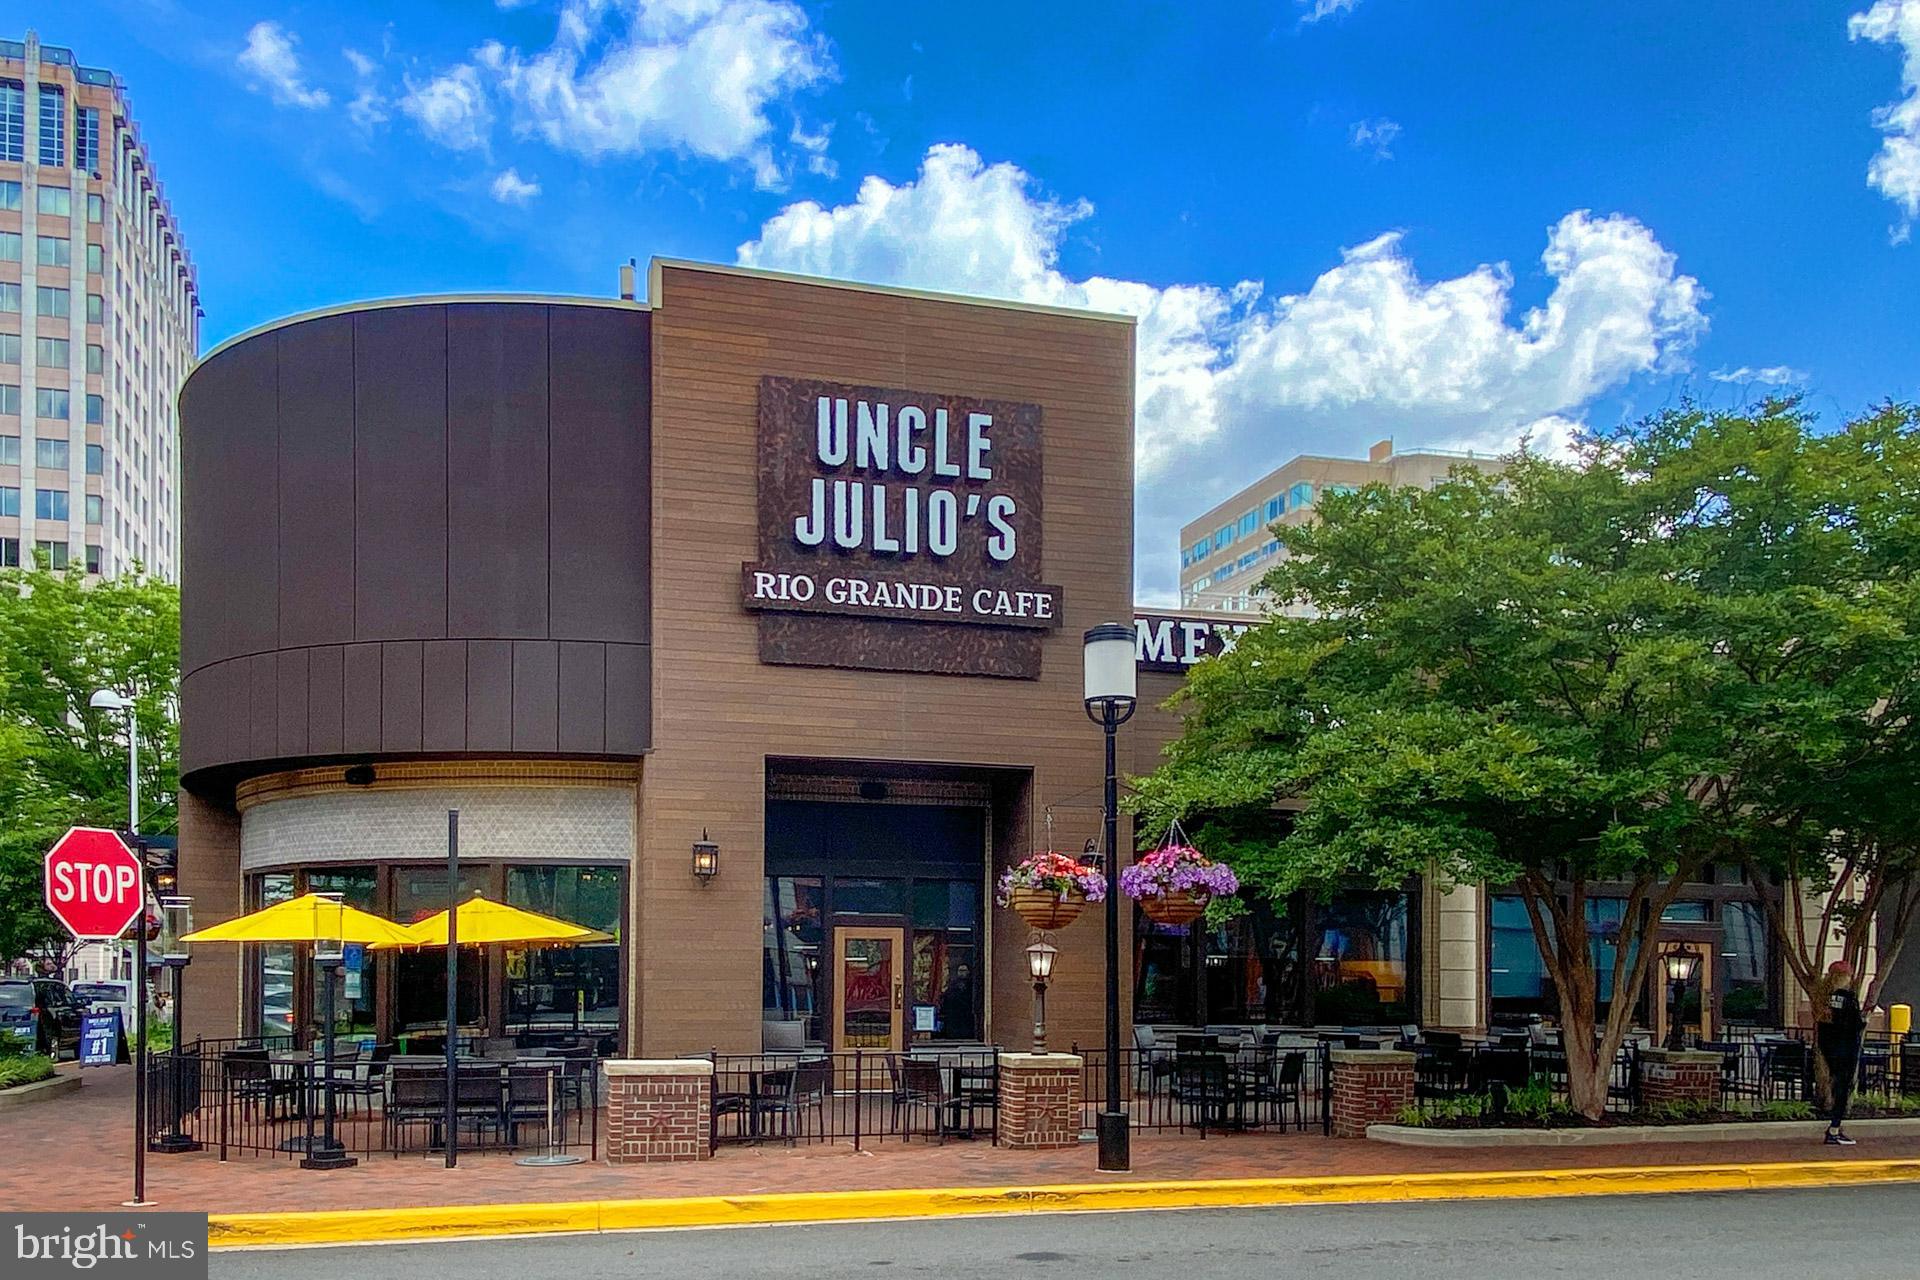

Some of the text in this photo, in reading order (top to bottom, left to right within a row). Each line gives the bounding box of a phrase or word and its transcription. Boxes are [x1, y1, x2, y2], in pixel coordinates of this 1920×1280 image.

[818, 396, 993, 480] UNCLE
[795, 478, 1017, 561] JULIO'S
[753, 572, 1053, 618] RIO GRANDE CAFE
[54, 861, 136, 904] STOP
